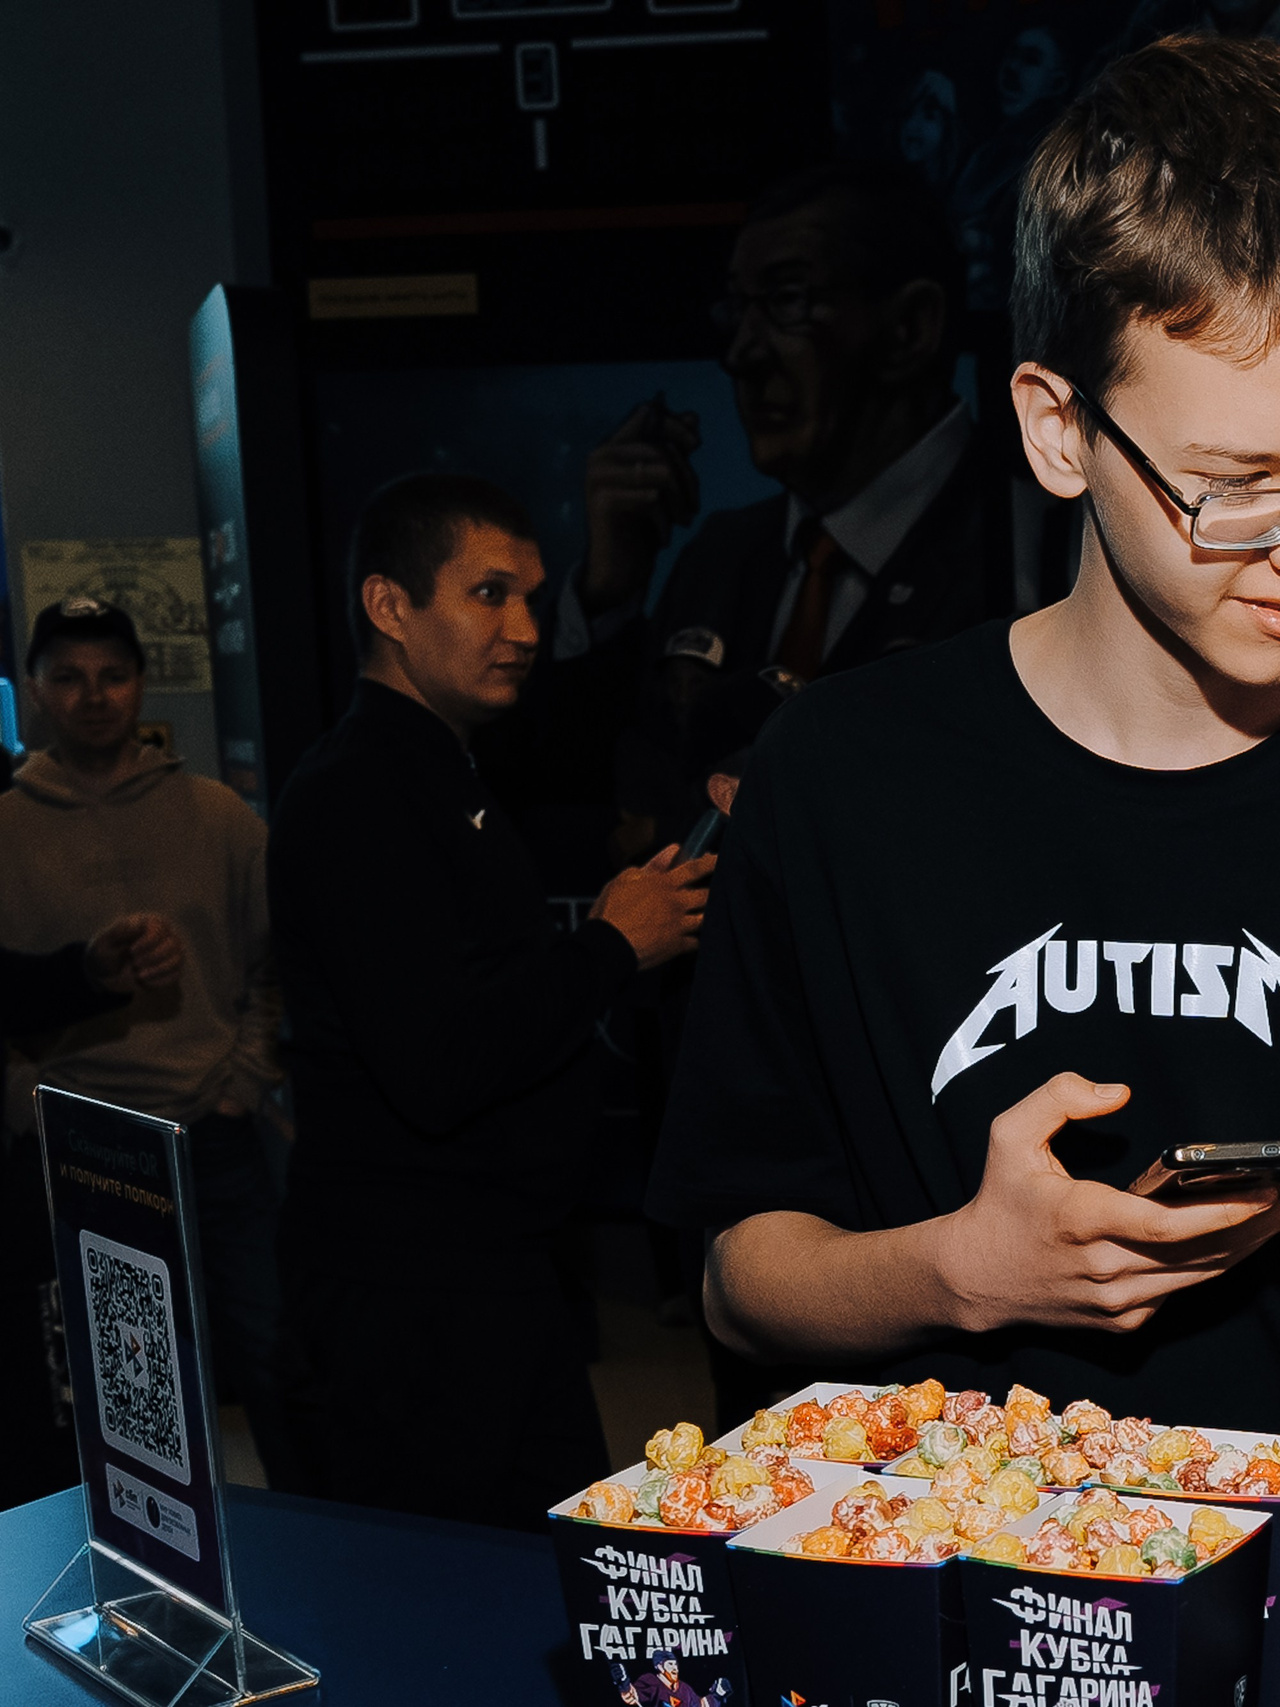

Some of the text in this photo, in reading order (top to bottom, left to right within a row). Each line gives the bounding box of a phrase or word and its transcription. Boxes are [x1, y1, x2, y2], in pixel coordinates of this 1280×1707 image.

[138, 1151, 159, 1178] QR
[59, 1163, 174, 1218] и получите попкорн
[580, 1545, 704, 1593] ФИНАЛ
[607, 1585, 715, 1624] КУБКА
[991, 1586, 1133, 1642] ФИНАЛ
[579, 1623, 728, 1660] ГАГАРИНА
[1020, 1629, 1143, 1676] КУБКА
[982, 1668, 1154, 1707] ГАГАРИНА
